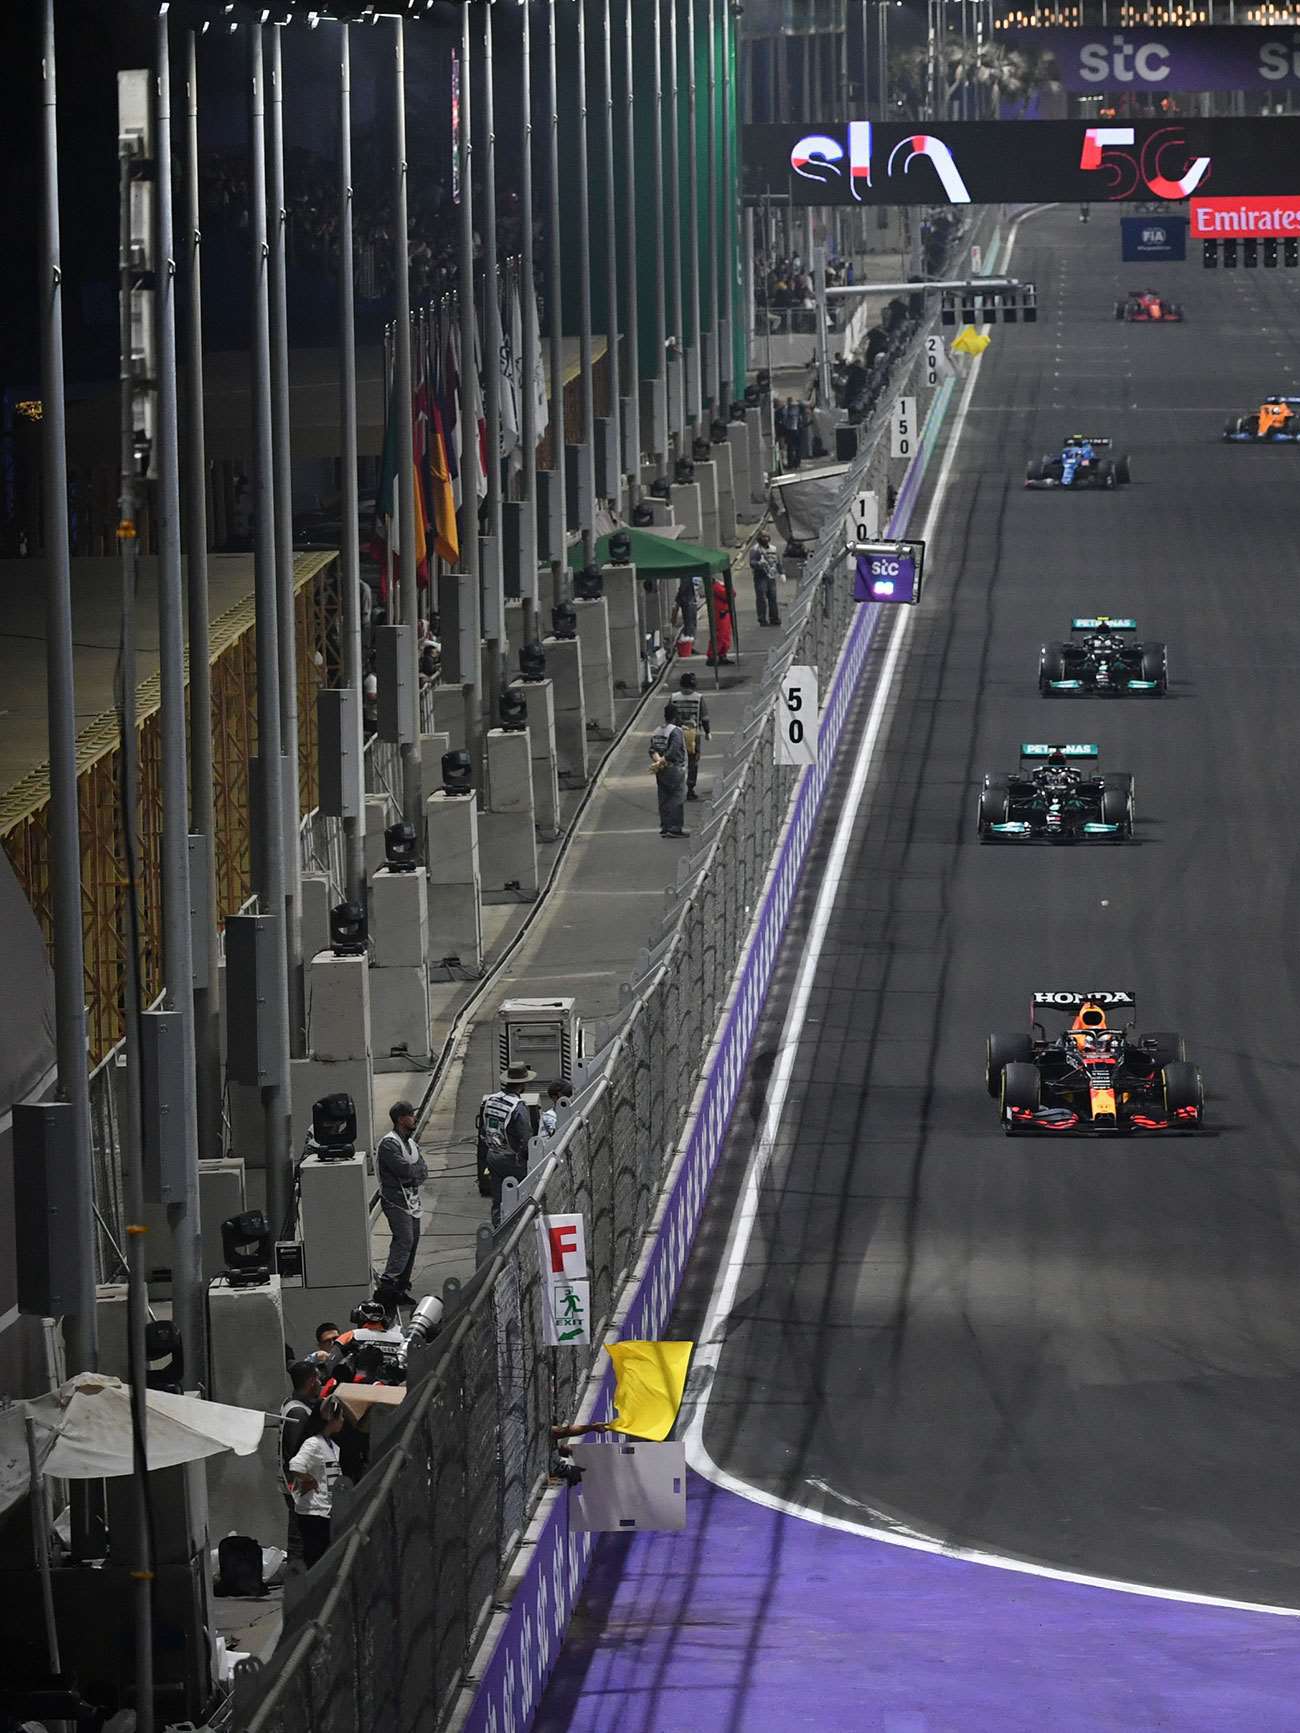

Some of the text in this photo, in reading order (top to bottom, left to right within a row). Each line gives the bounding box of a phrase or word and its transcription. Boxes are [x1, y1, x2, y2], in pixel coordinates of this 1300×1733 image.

[1079, 34, 1171, 82] stc
[871, 559, 899, 577] stc
[548, 1225, 577, 1273] F
